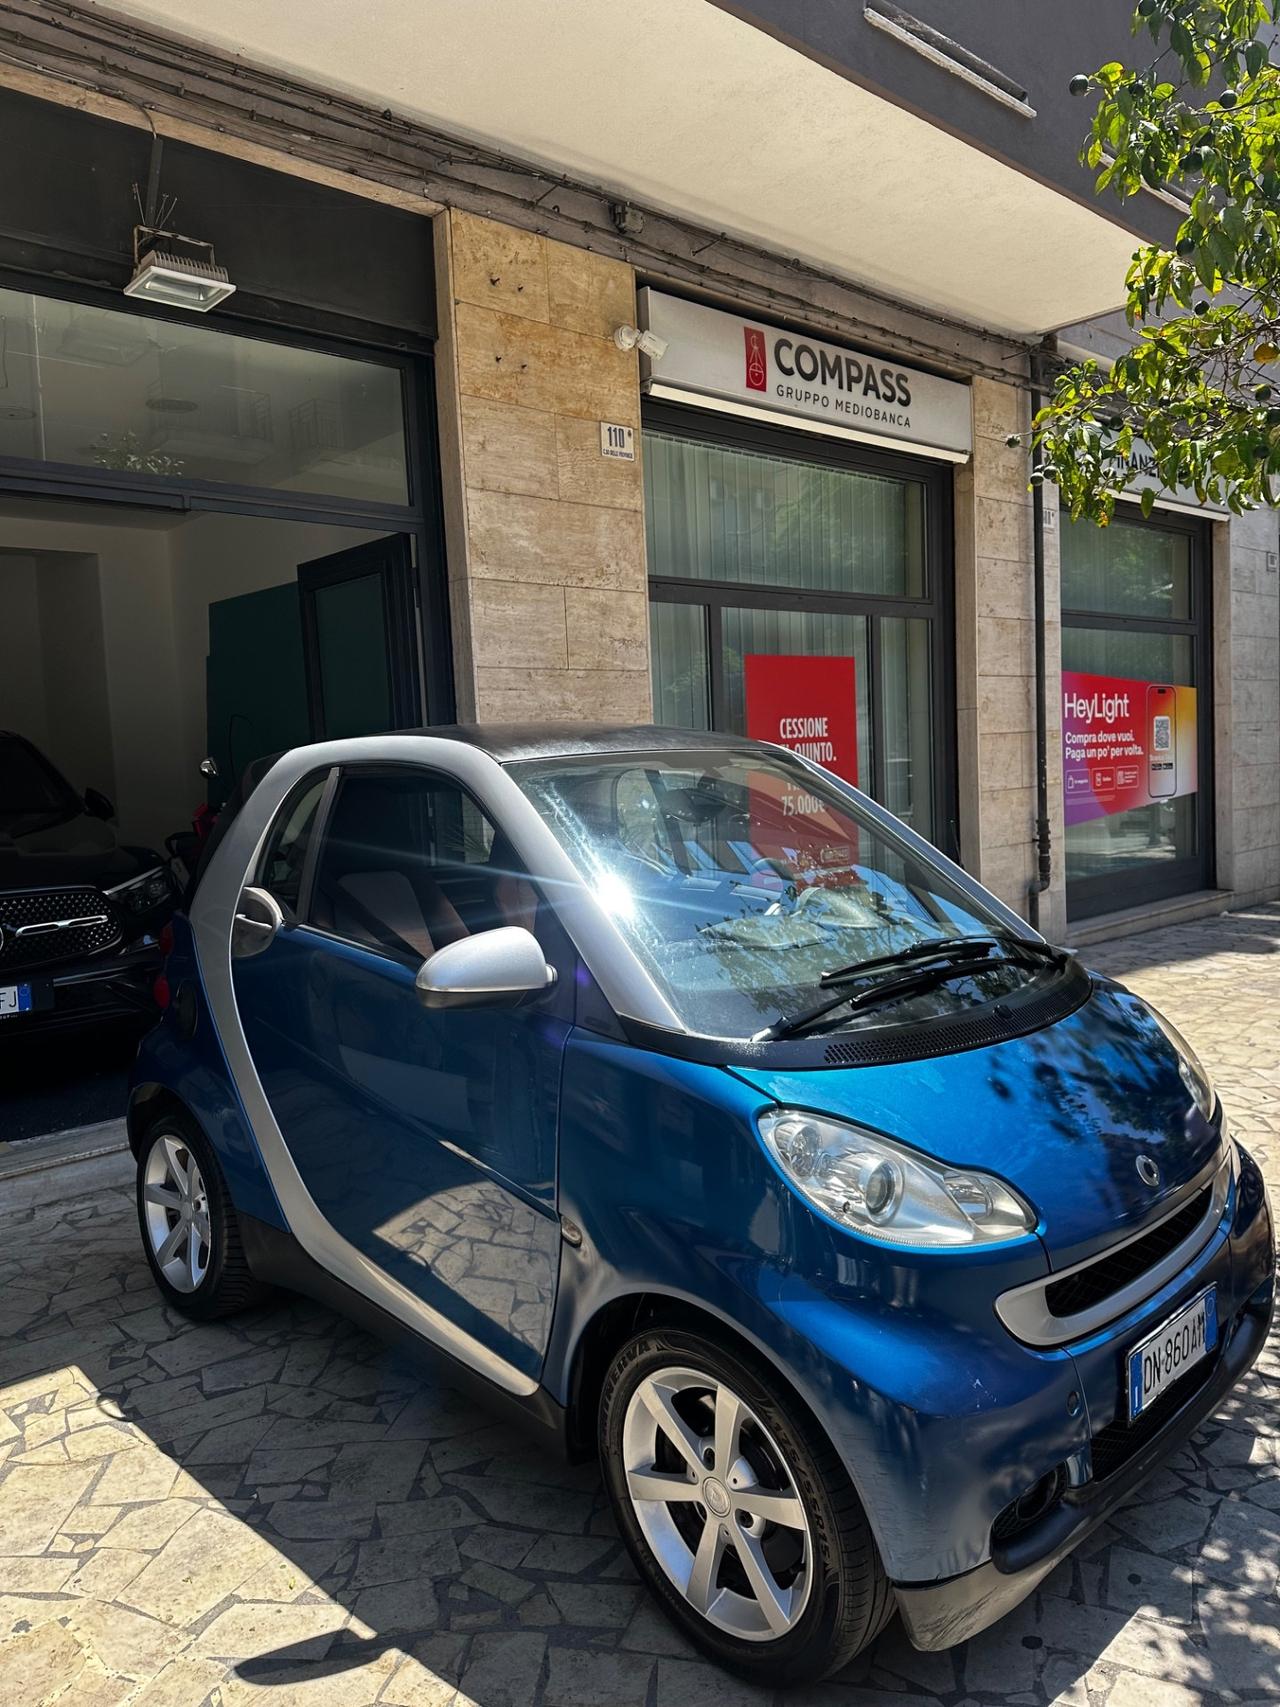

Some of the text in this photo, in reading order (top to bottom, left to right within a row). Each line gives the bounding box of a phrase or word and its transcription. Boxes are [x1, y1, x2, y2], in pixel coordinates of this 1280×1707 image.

[774, 338, 911, 407] COMPASS
[776, 384, 911, 428] GRUPPO MEDIOBANCA
[607, 426, 625, 448] 110
[1064, 692, 1130, 724] HeyLight
[779, 717, 829, 739] CESSIONE
[1065, 729, 1135, 746] Compra dove vuoi.
[1065, 744, 1144, 762] Paga un po' per volta.
